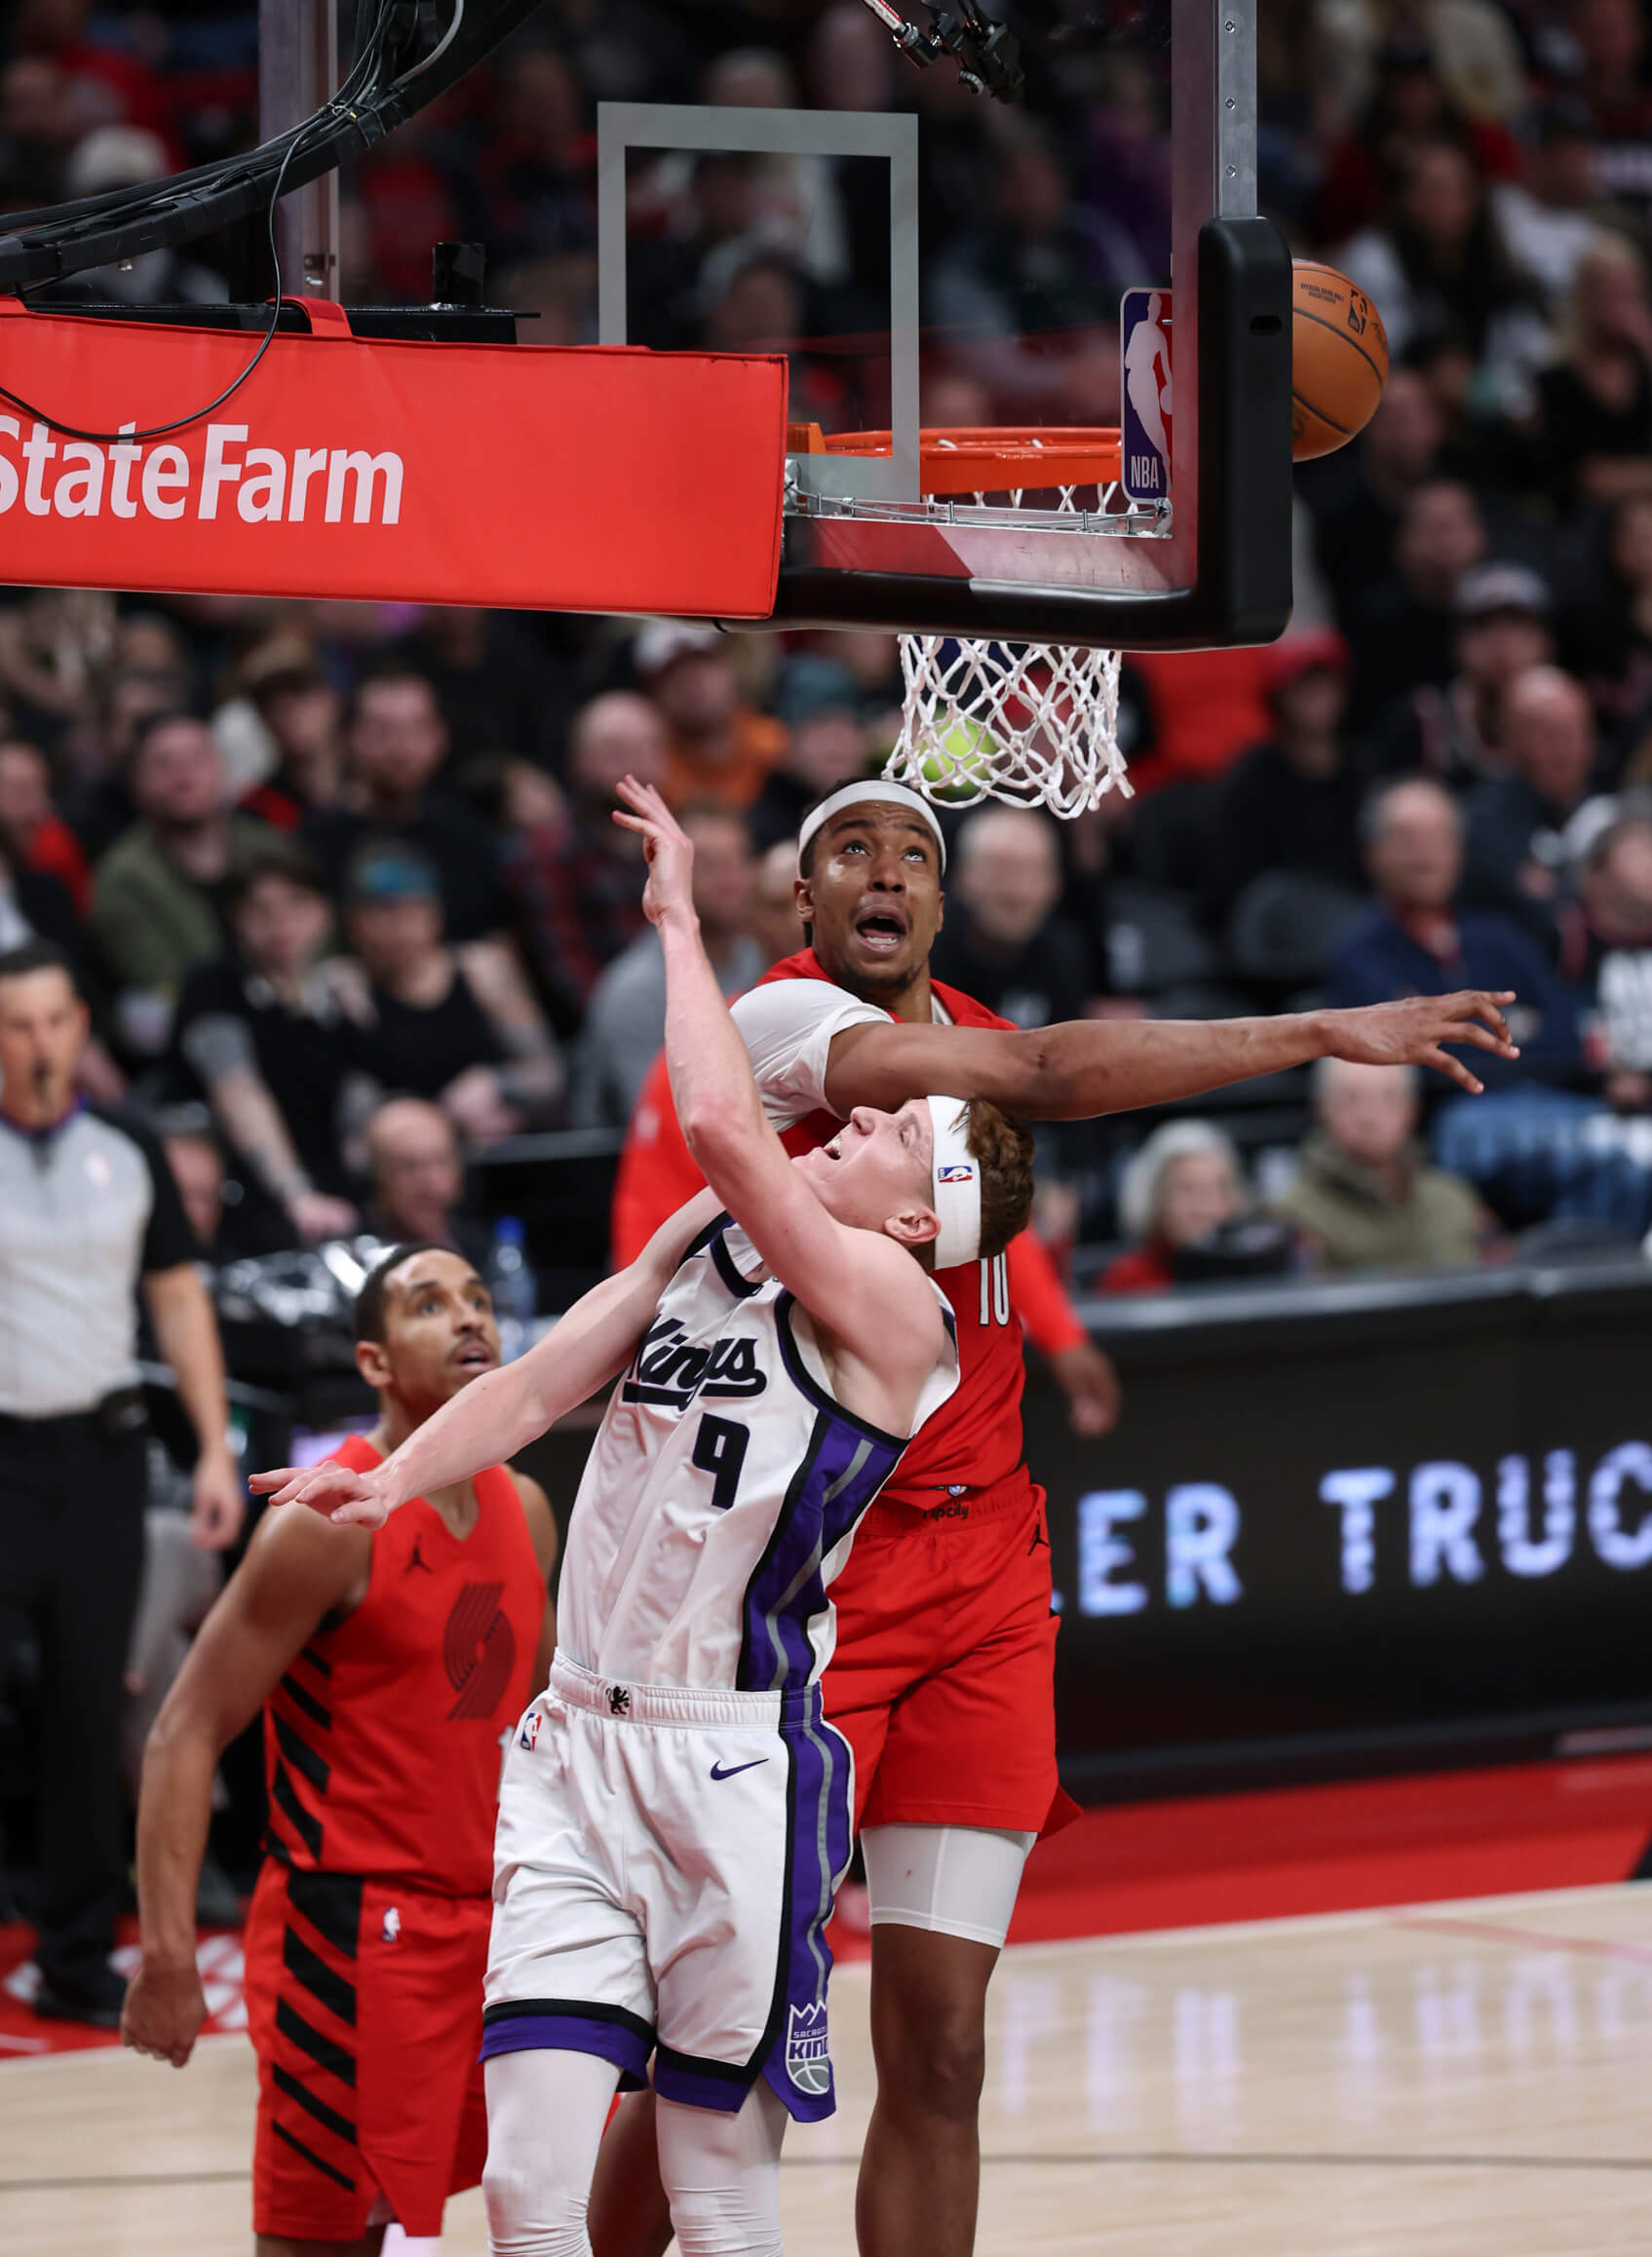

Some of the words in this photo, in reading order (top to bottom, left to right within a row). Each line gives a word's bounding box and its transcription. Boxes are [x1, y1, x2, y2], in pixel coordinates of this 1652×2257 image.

[1131, 455, 1159, 488] NBA
[692, 1412, 750, 1511] 9
[1052, 1482, 1243, 1618] ER
[1319, 1441, 1652, 1594] TRUC
[789, 2038, 827, 2059] KIN
